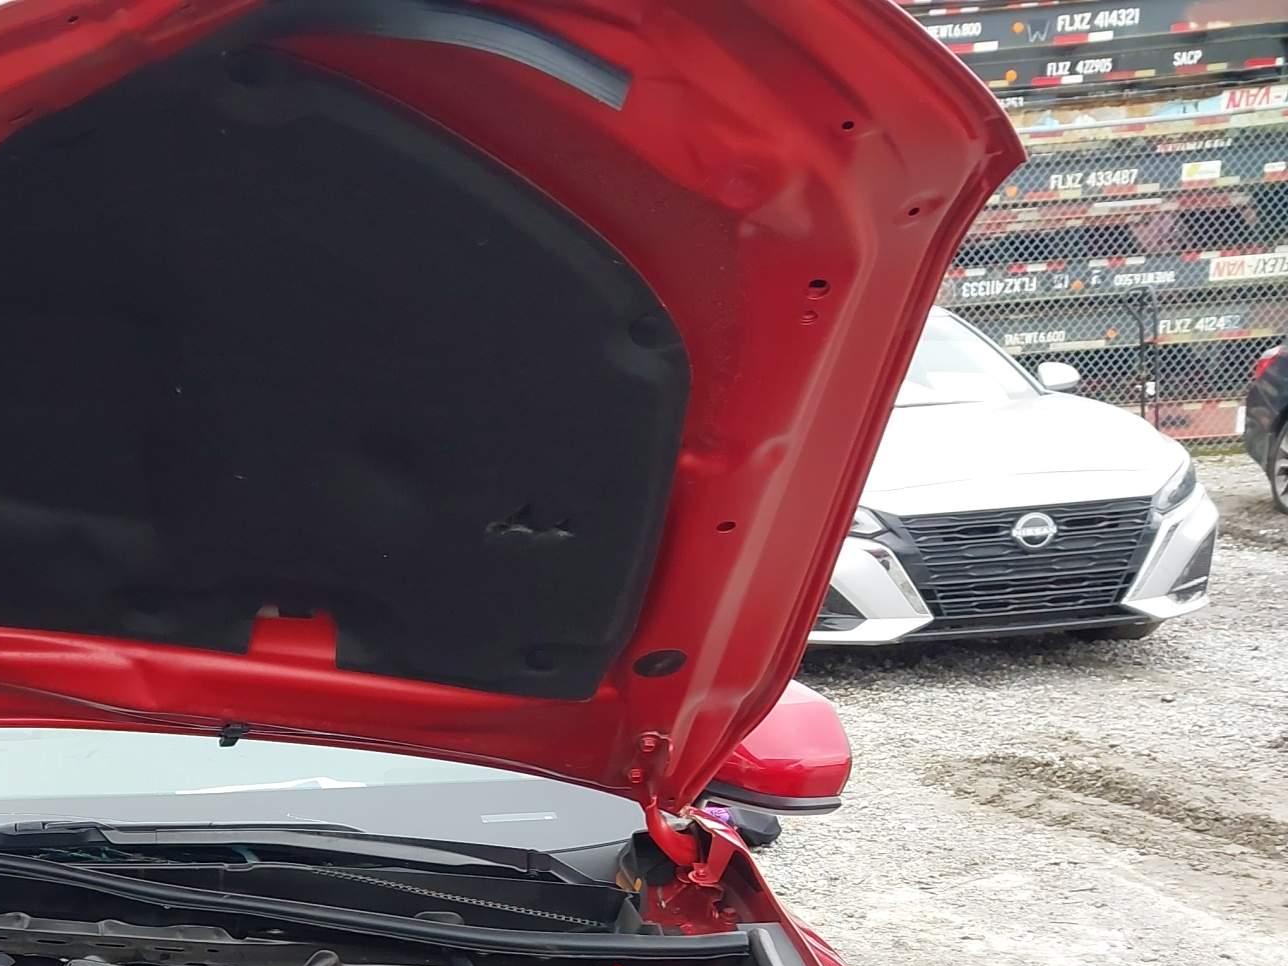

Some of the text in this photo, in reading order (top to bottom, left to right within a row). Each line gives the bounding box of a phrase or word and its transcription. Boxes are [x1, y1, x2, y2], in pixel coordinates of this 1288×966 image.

[1057, 8, 1140, 32] FLXZ 414321
[1173, 50, 1202, 66] SACP
